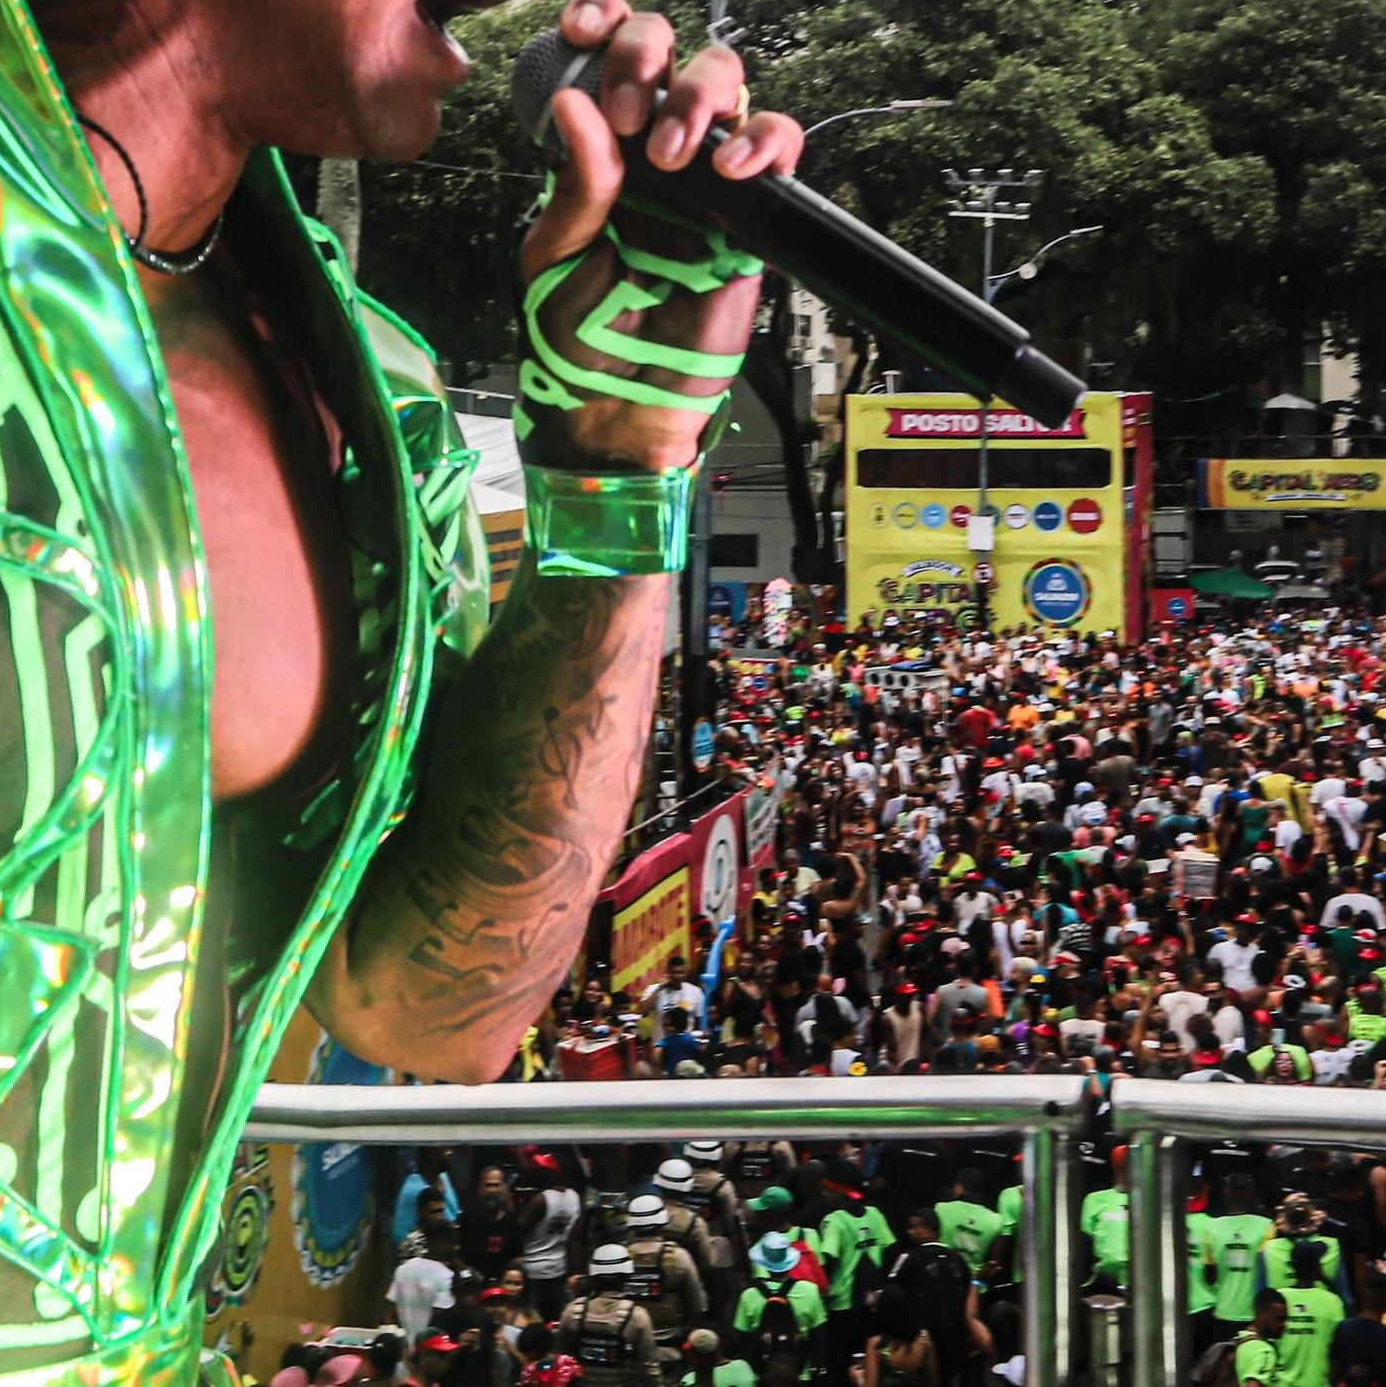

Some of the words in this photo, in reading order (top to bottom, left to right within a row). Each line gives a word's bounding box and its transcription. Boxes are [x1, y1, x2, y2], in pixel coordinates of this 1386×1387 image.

[900, 414, 979, 432] POSTO
[1228, 470, 1317, 491] CAPITAL
[877, 578, 983, 604] CAPITA
